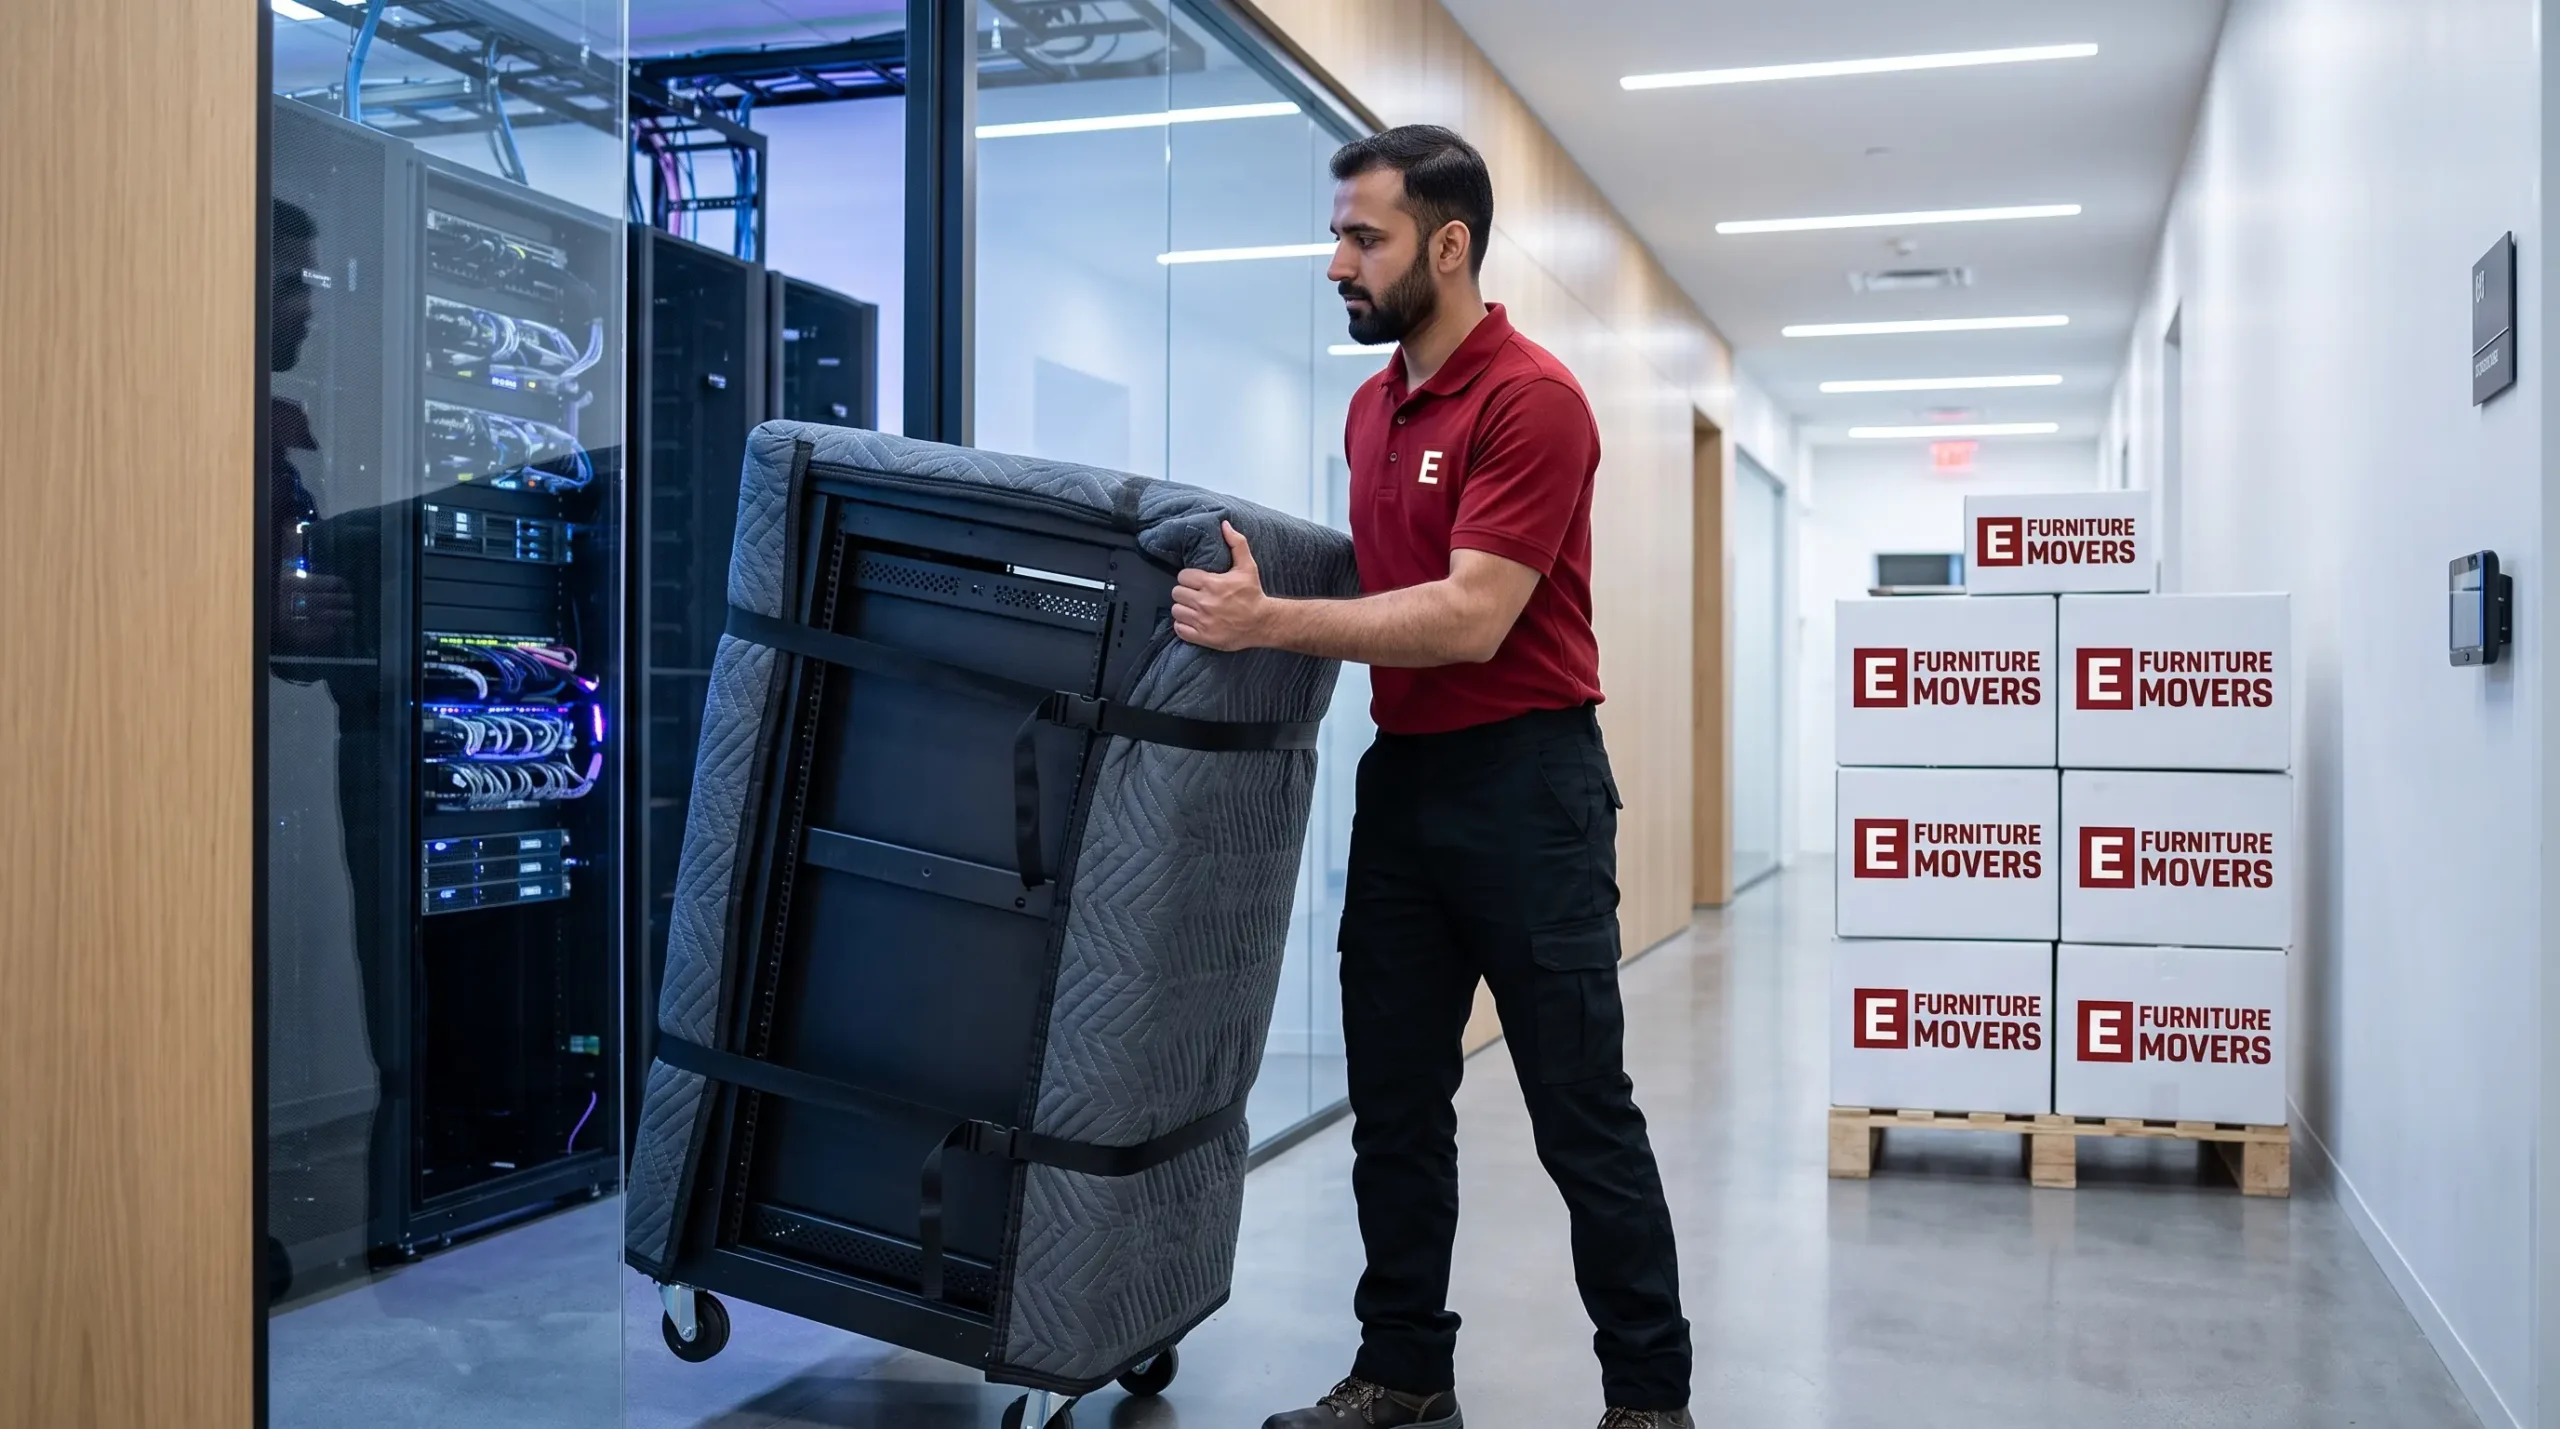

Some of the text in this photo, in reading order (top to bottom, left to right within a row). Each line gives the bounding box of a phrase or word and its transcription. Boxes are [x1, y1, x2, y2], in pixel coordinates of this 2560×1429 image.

[1418, 450, 1443, 485] E
[1988, 525, 2013, 559] E
[2027, 518, 2136, 537] FURNITURE
[2027, 540, 2136, 564] MOVERS
[1914, 651, 2041, 672] FURNITURE
[2140, 651, 2273, 673] FURNITURE
[1866, 658, 1896, 698] E
[1914, 677, 2041, 705] MOVERS
[2089, 658, 2121, 700] E
[2140, 678, 2273, 708] MOVERS
[1867, 828, 1897, 869] E
[1915, 823, 2042, 845] FURNITURE
[2141, 831, 2273, 854] FURNITURE
[1915, 850, 2042, 879] MOVERS
[2091, 837, 2123, 878] E
[2141, 858, 2273, 889] MOVERS
[1866, 998, 1897, 1040] E
[1914, 993, 2041, 1017] FURNITURE
[2140, 1006, 2272, 1031] FURNITURE
[1914, 1020, 2042, 1050] MOVERS
[2090, 1010, 2121, 1053] E
[2140, 1033, 2272, 1065] MOVERS
